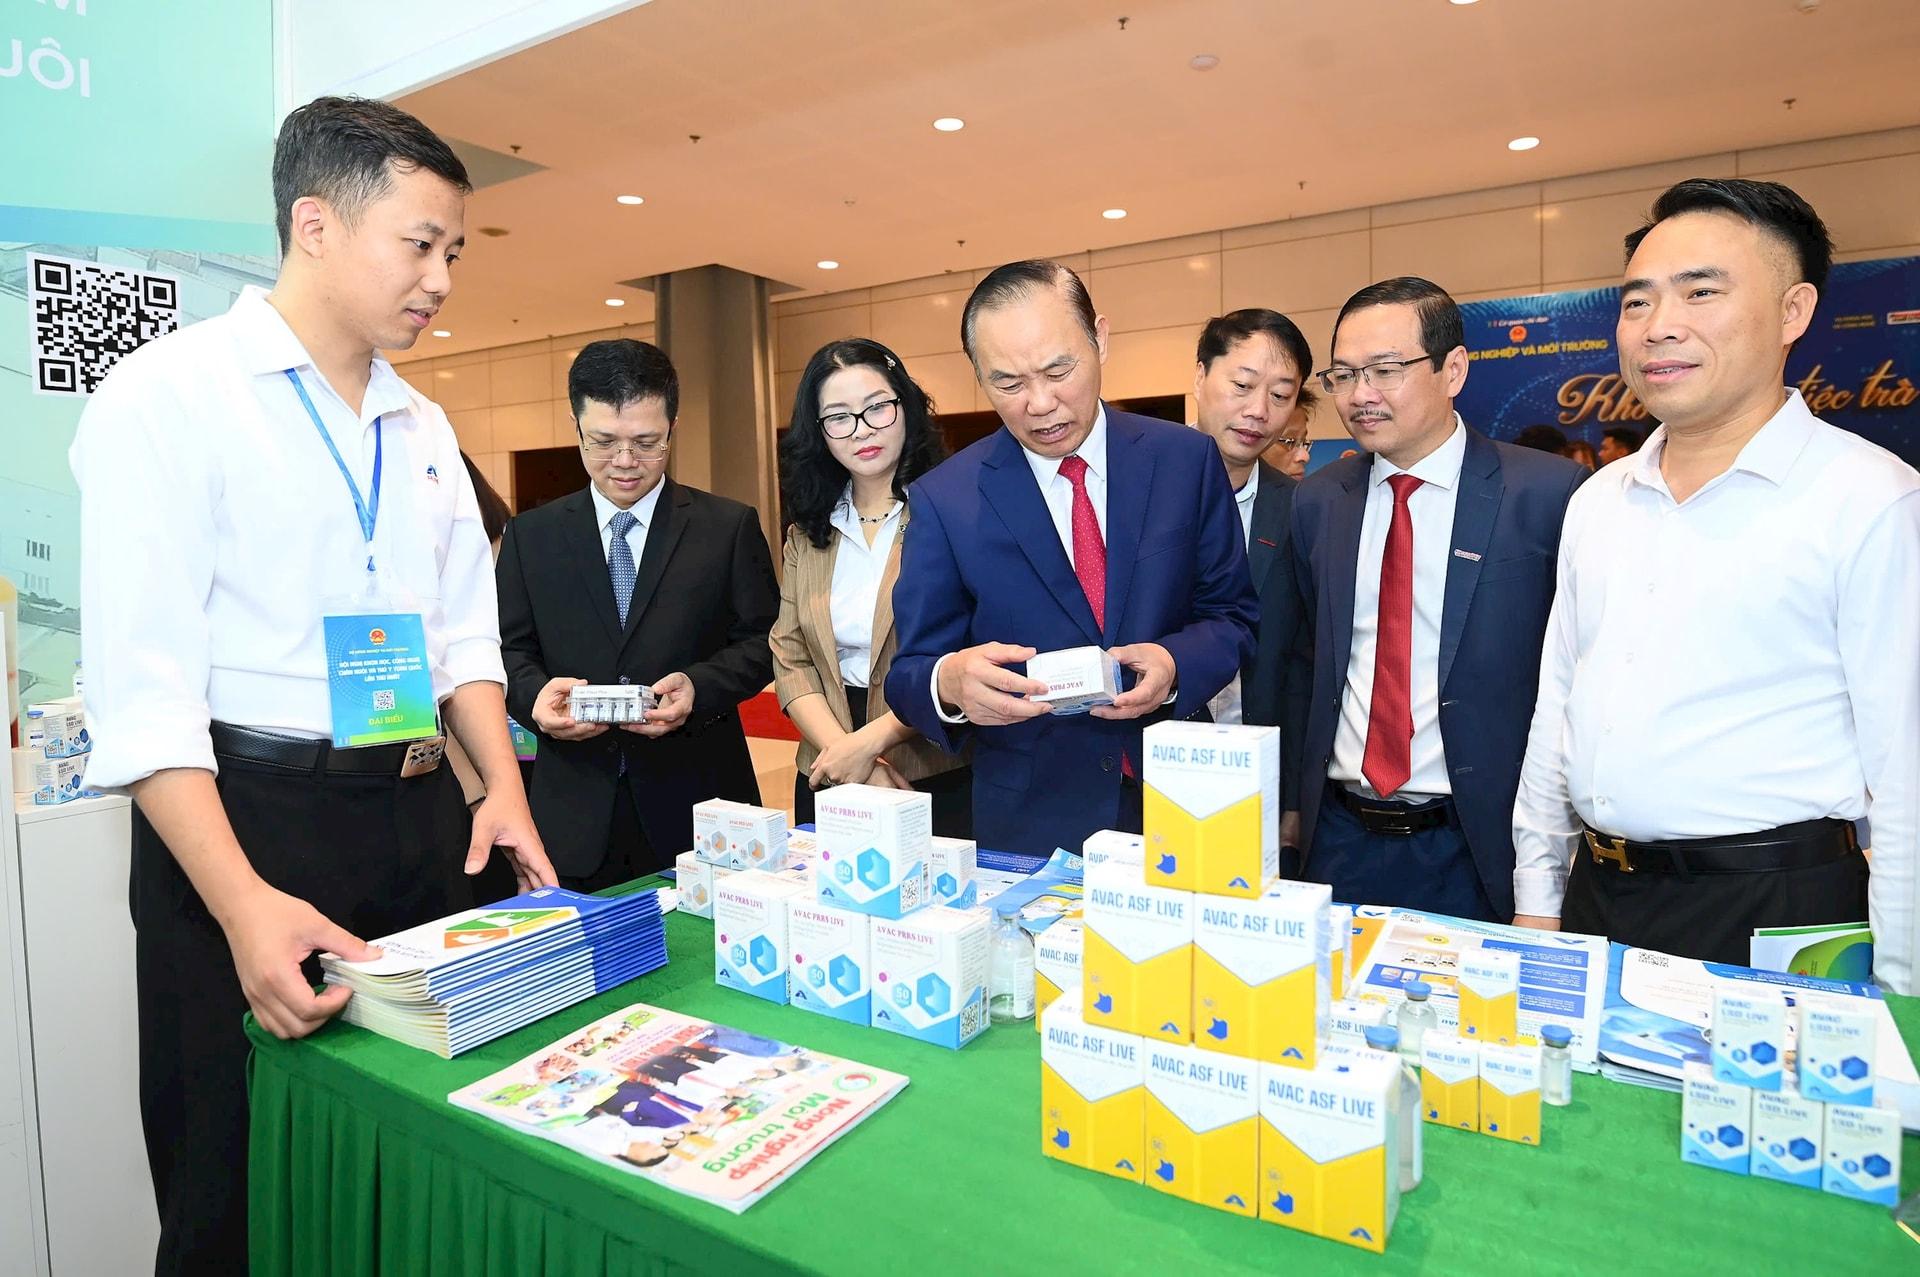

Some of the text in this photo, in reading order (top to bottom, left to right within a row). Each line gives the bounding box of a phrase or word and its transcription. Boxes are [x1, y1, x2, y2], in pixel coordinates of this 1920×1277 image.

[1468, 351, 1480, 361] NG
[1152, 744, 1252, 768] AVAC ASF LIVE
[820, 804, 874, 820] AVAC PRRS LIVE
[718, 892, 734, 902] AVAC
[750, 899, 763, 909] LIVE
[1091, 888, 1184, 919] AVAC ASF LIVE
[793, 909, 811, 920] AVAC
[830, 917, 845, 927] LIVE
[1203, 908, 1305, 939] AVAC ASF LIVE
[876, 926, 896, 937] AVAC
[917, 933, 934, 945] LIVE
[1040, 947, 1079, 964] AVAC ASF
[896, 987, 909, 999] 50
[1337, 1020, 1368, 1033] ASF LIV
[1048, 1027, 1136, 1062] AVAC ASF LIVE
[1152, 1053, 1248, 1092] AVAC ASF LIVE
[1268, 1079, 1375, 1118] AVAC ASF LIVE
